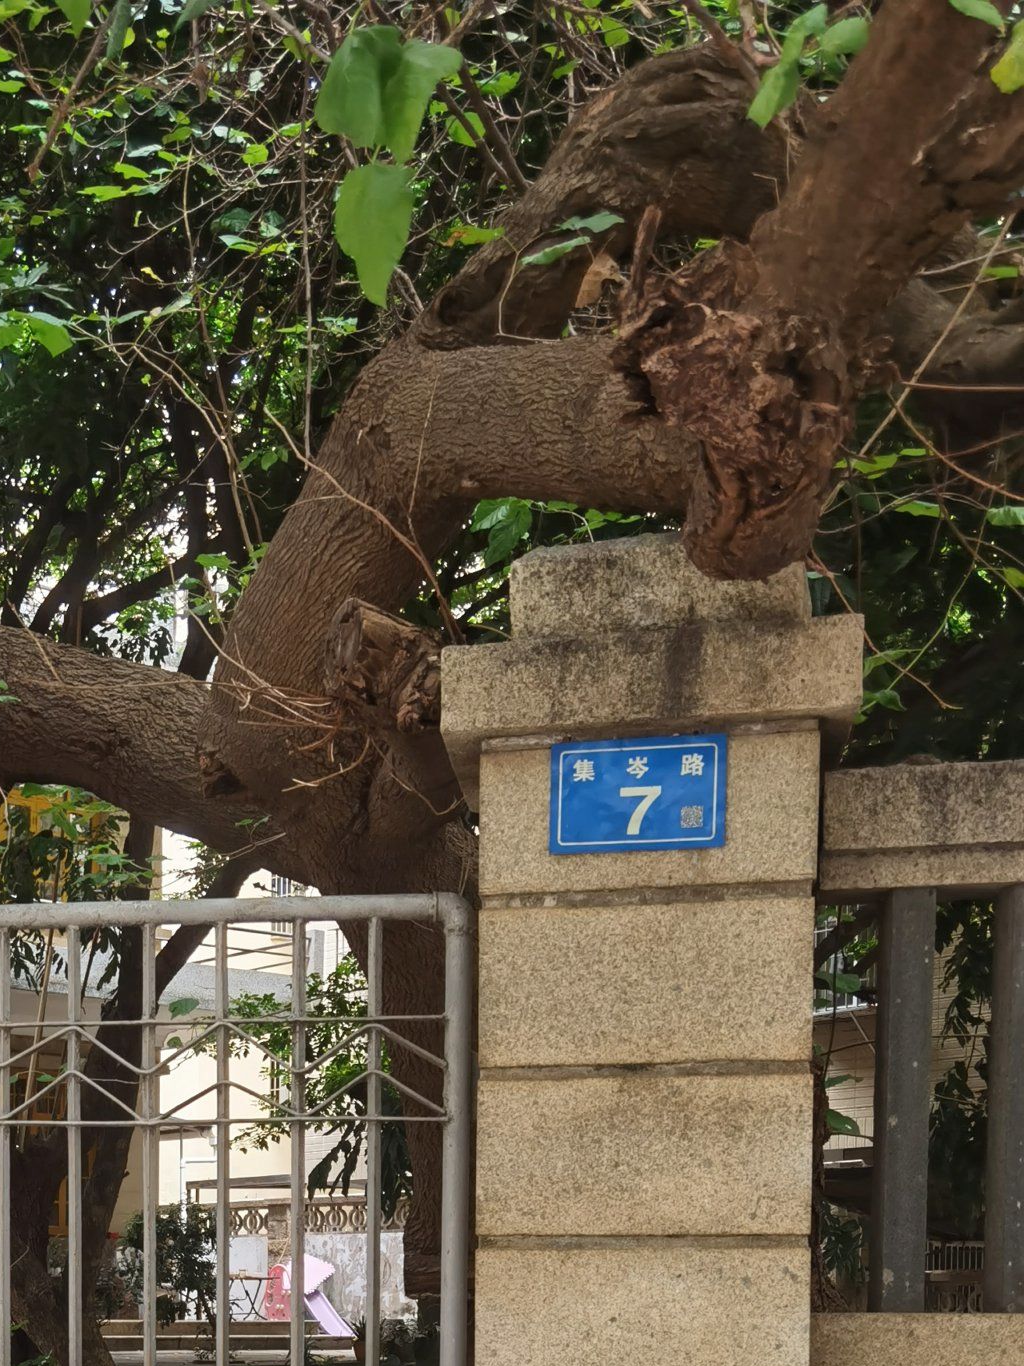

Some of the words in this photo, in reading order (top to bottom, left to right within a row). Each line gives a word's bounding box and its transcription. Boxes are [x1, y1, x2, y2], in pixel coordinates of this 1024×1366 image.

[573, 753, 705, 782] 集岑路
[619, 785, 662, 836] 7
